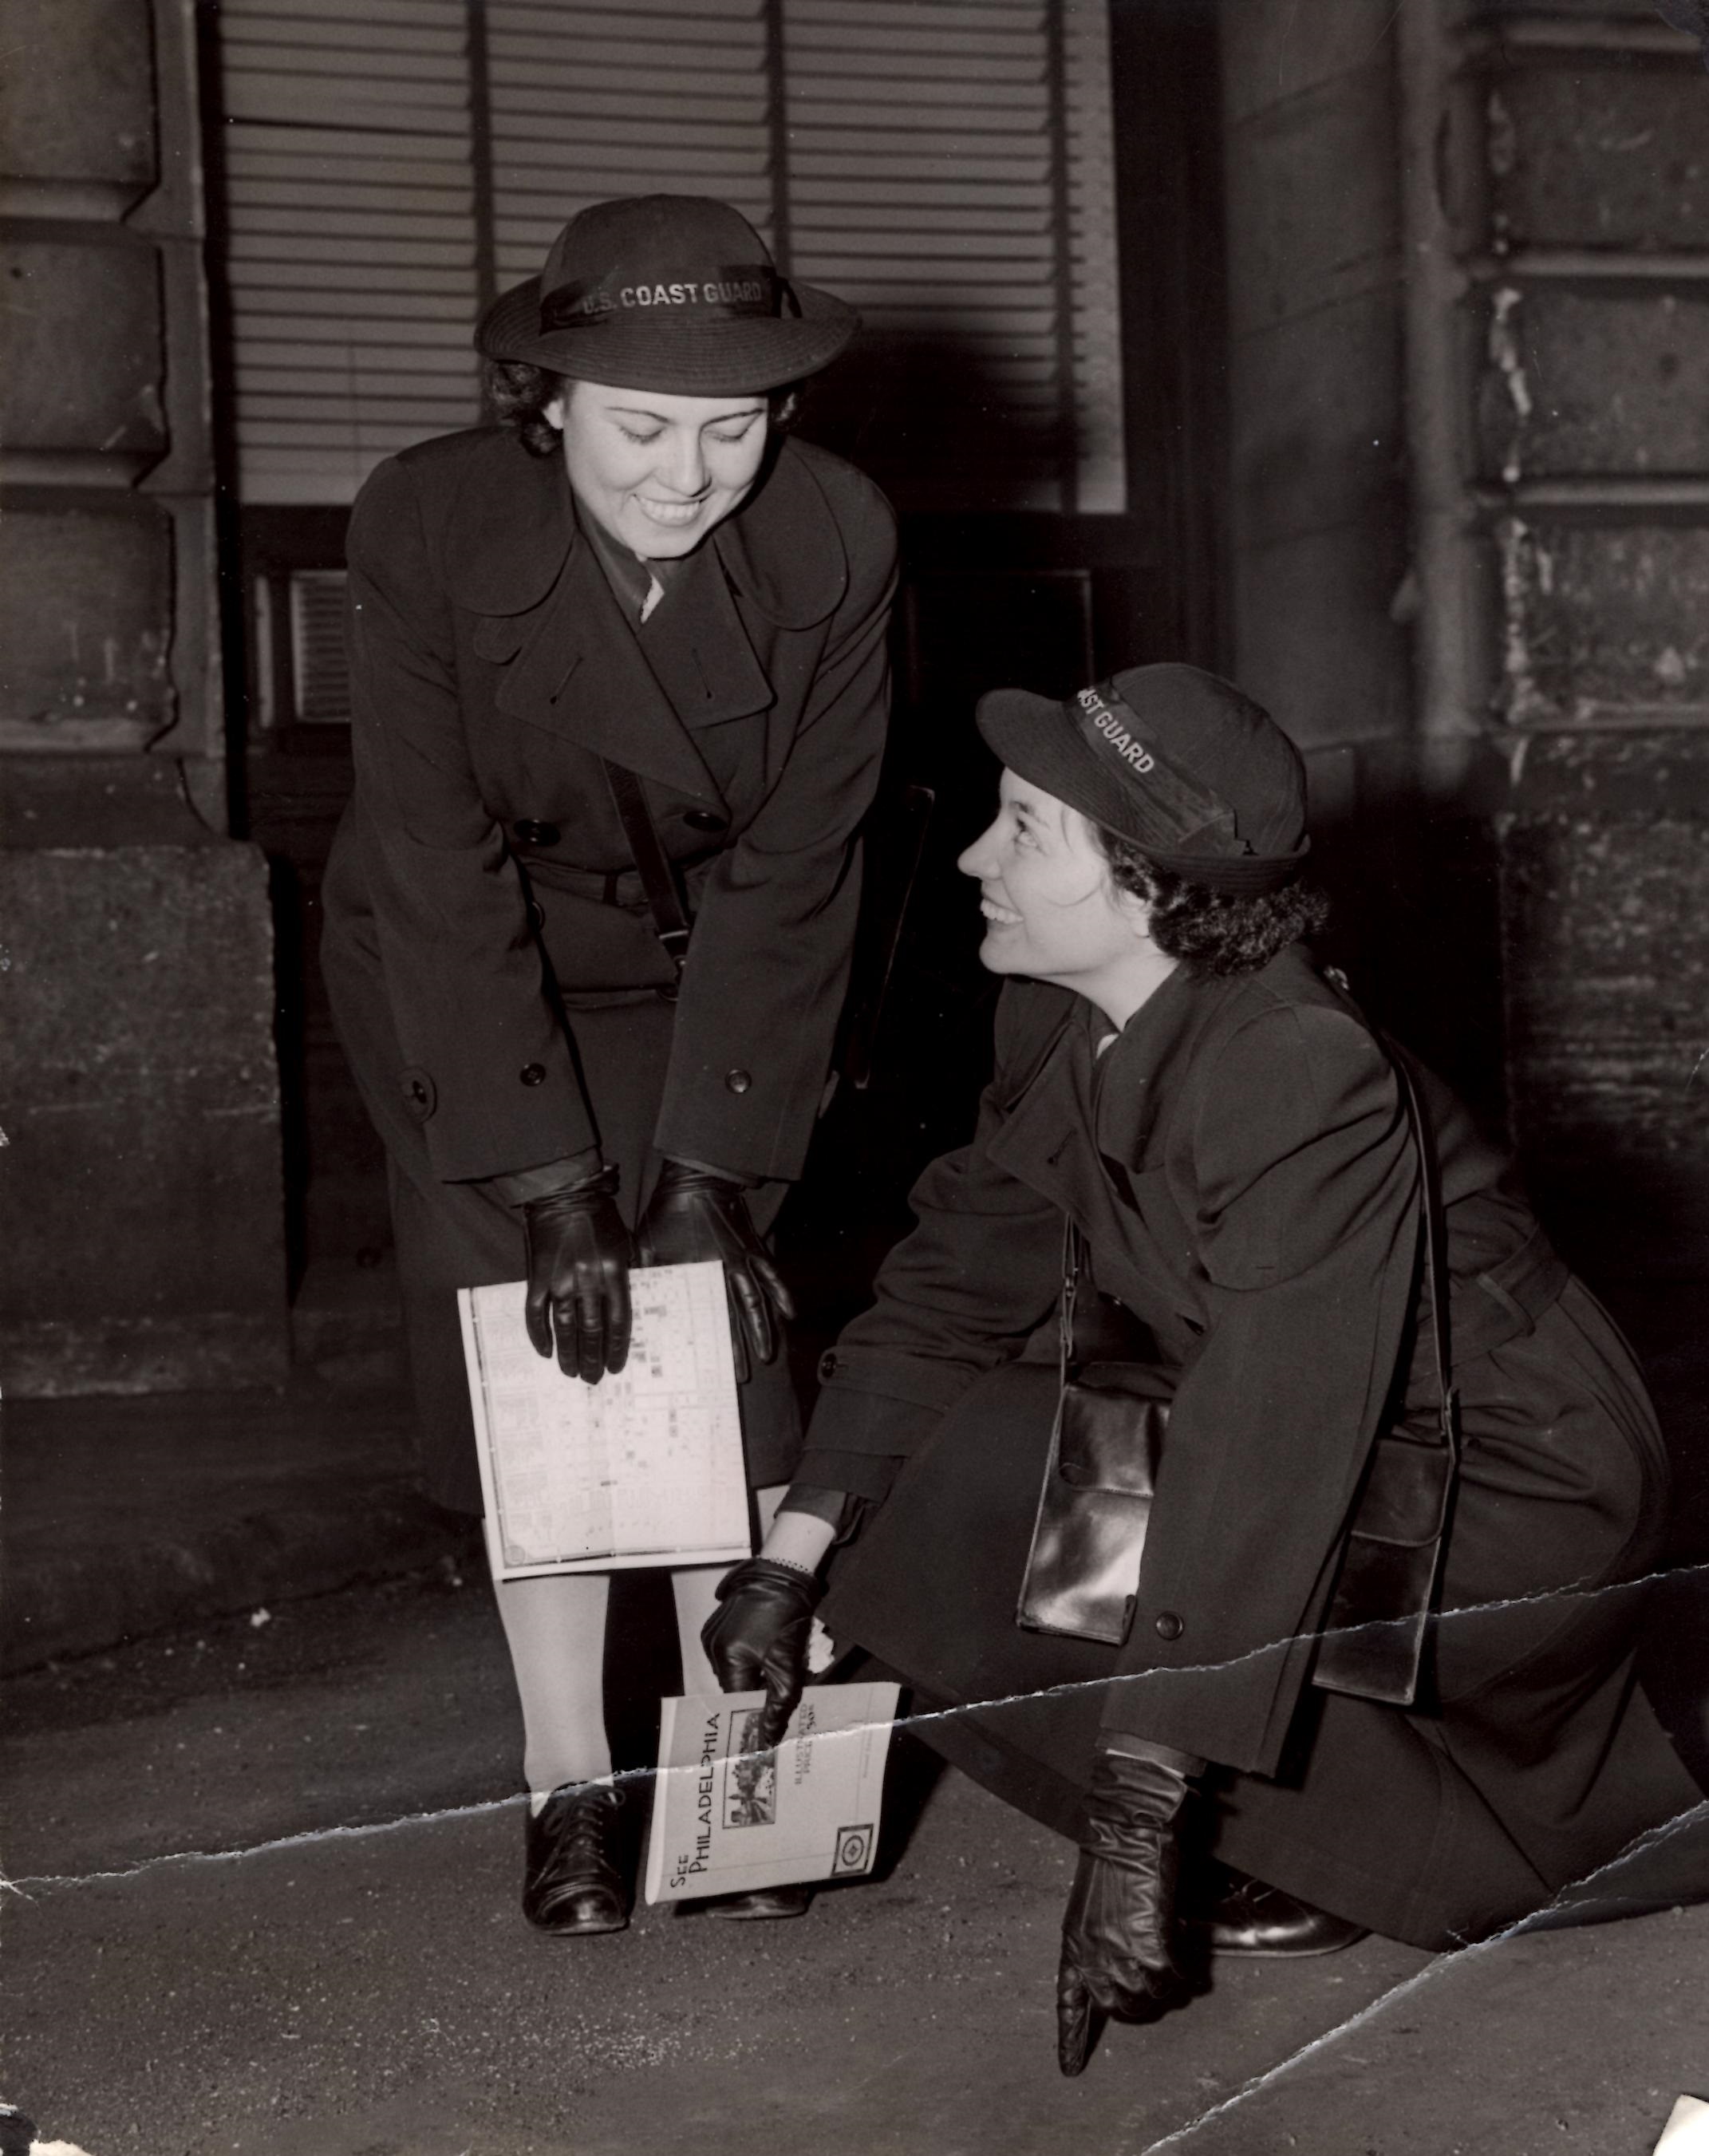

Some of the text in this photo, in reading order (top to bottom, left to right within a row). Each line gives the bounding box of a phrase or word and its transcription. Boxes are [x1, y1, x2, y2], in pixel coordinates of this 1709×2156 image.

[583, 282, 762, 314] U.S. COAST GUARD
[1094, 711, 1155, 773] GUARD
[688, 1712, 720, 1874] PHILADELPHIA
[669, 1854, 689, 1888] SEE
